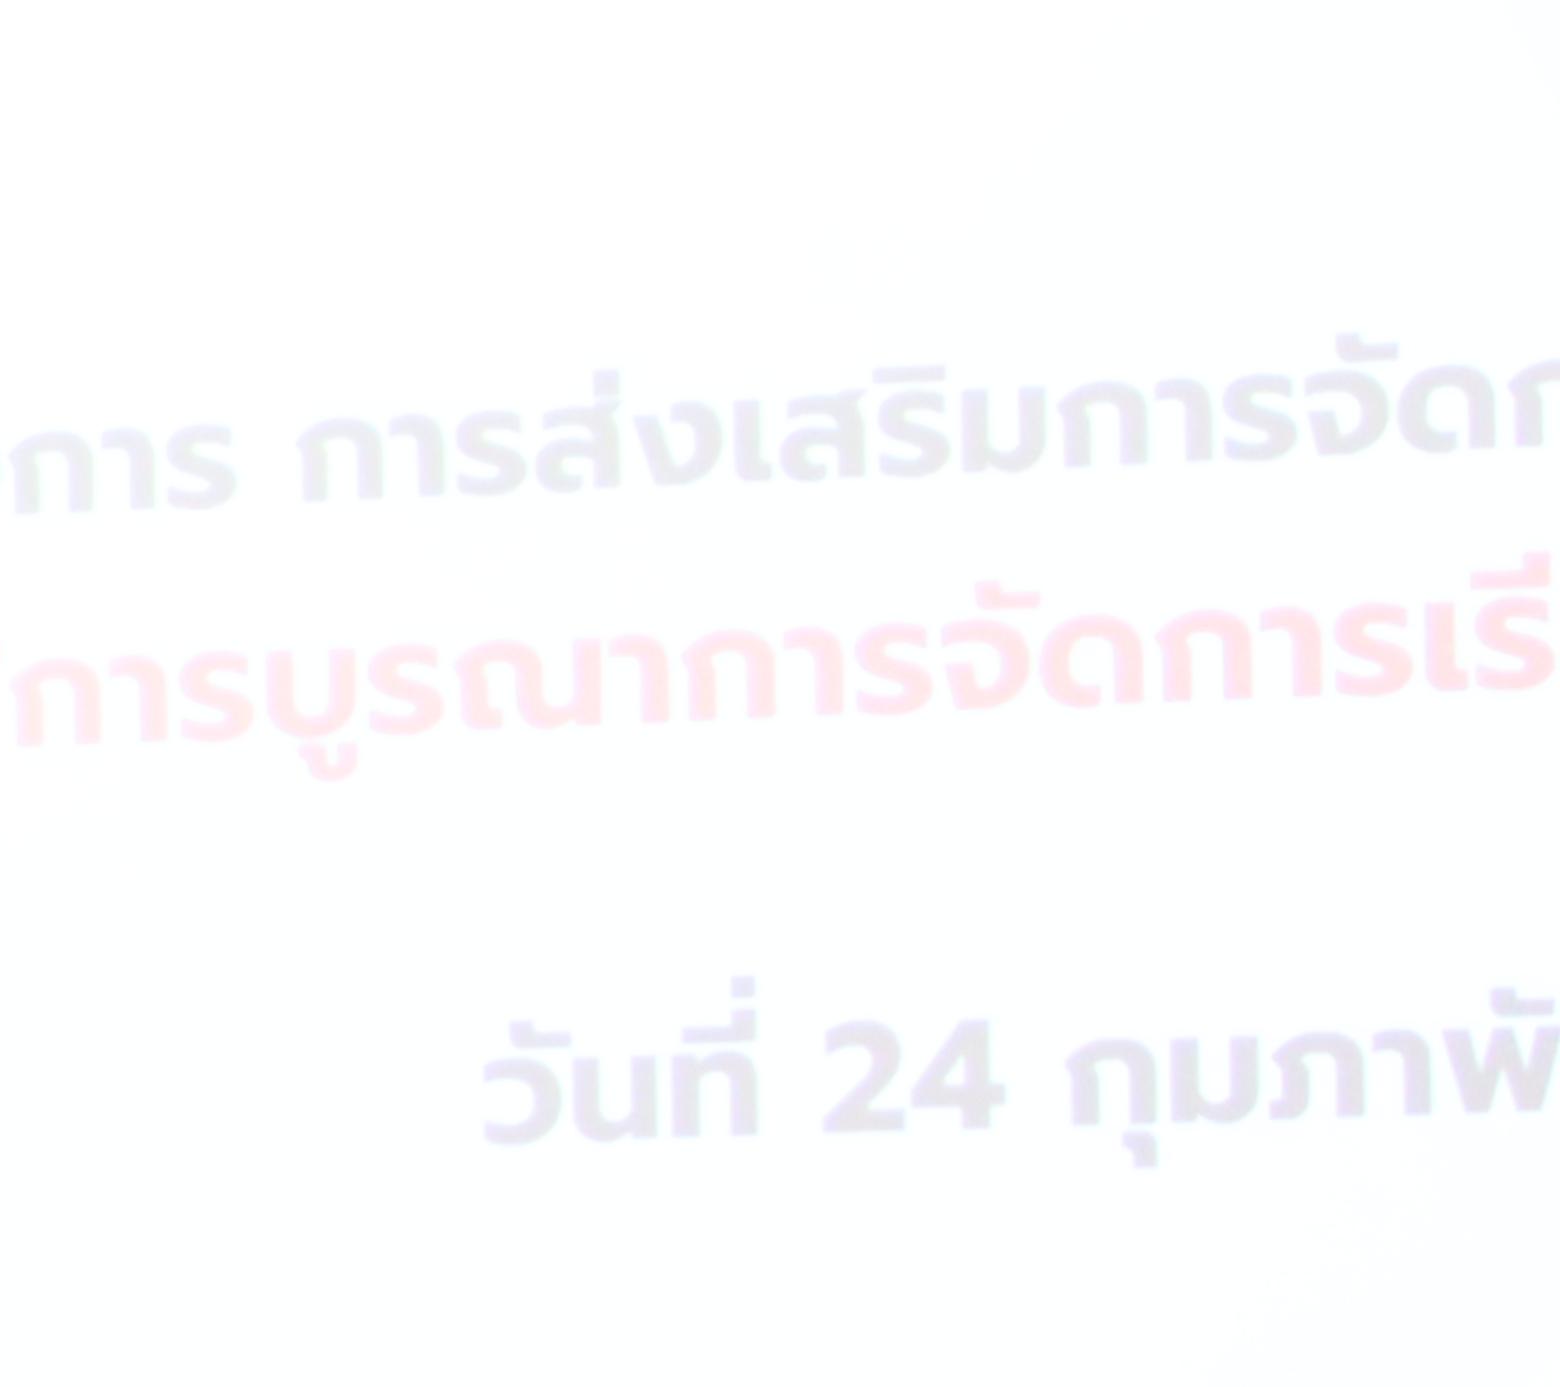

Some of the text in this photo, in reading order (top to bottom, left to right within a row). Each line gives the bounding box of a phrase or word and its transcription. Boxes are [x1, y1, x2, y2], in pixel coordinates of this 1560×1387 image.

[483, 975, 762, 1148] วันที่
[821, 1017, 1010, 1135] 24
